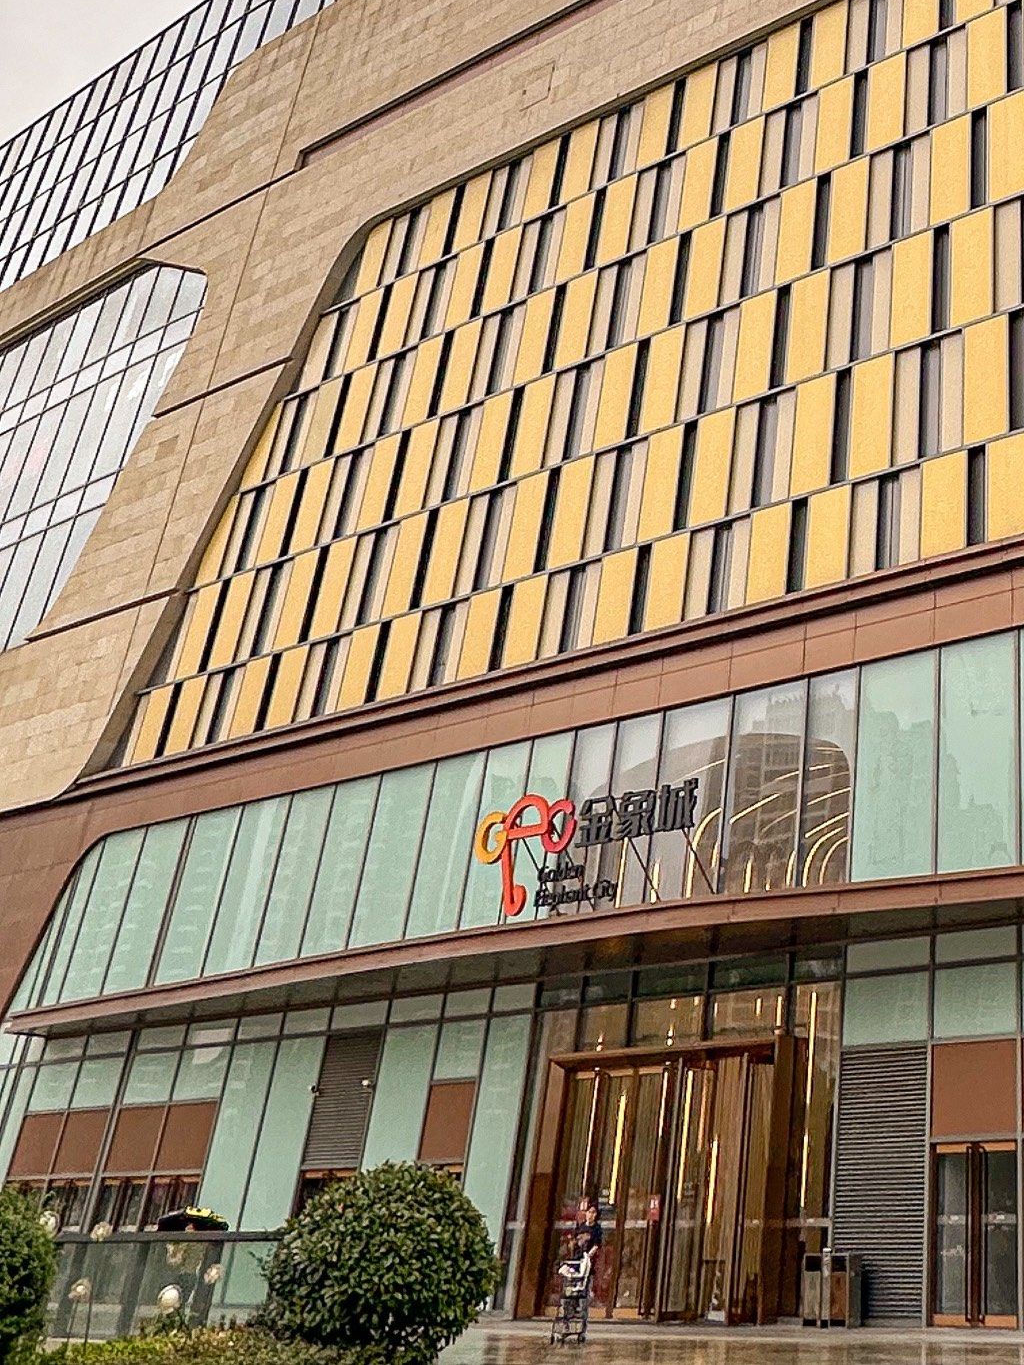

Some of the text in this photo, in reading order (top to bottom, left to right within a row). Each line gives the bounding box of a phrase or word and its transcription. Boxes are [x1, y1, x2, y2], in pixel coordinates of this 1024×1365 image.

[575, 778, 698, 848] 金象城
[538, 862, 584, 883] Golden
[593, 879, 618, 902] City
